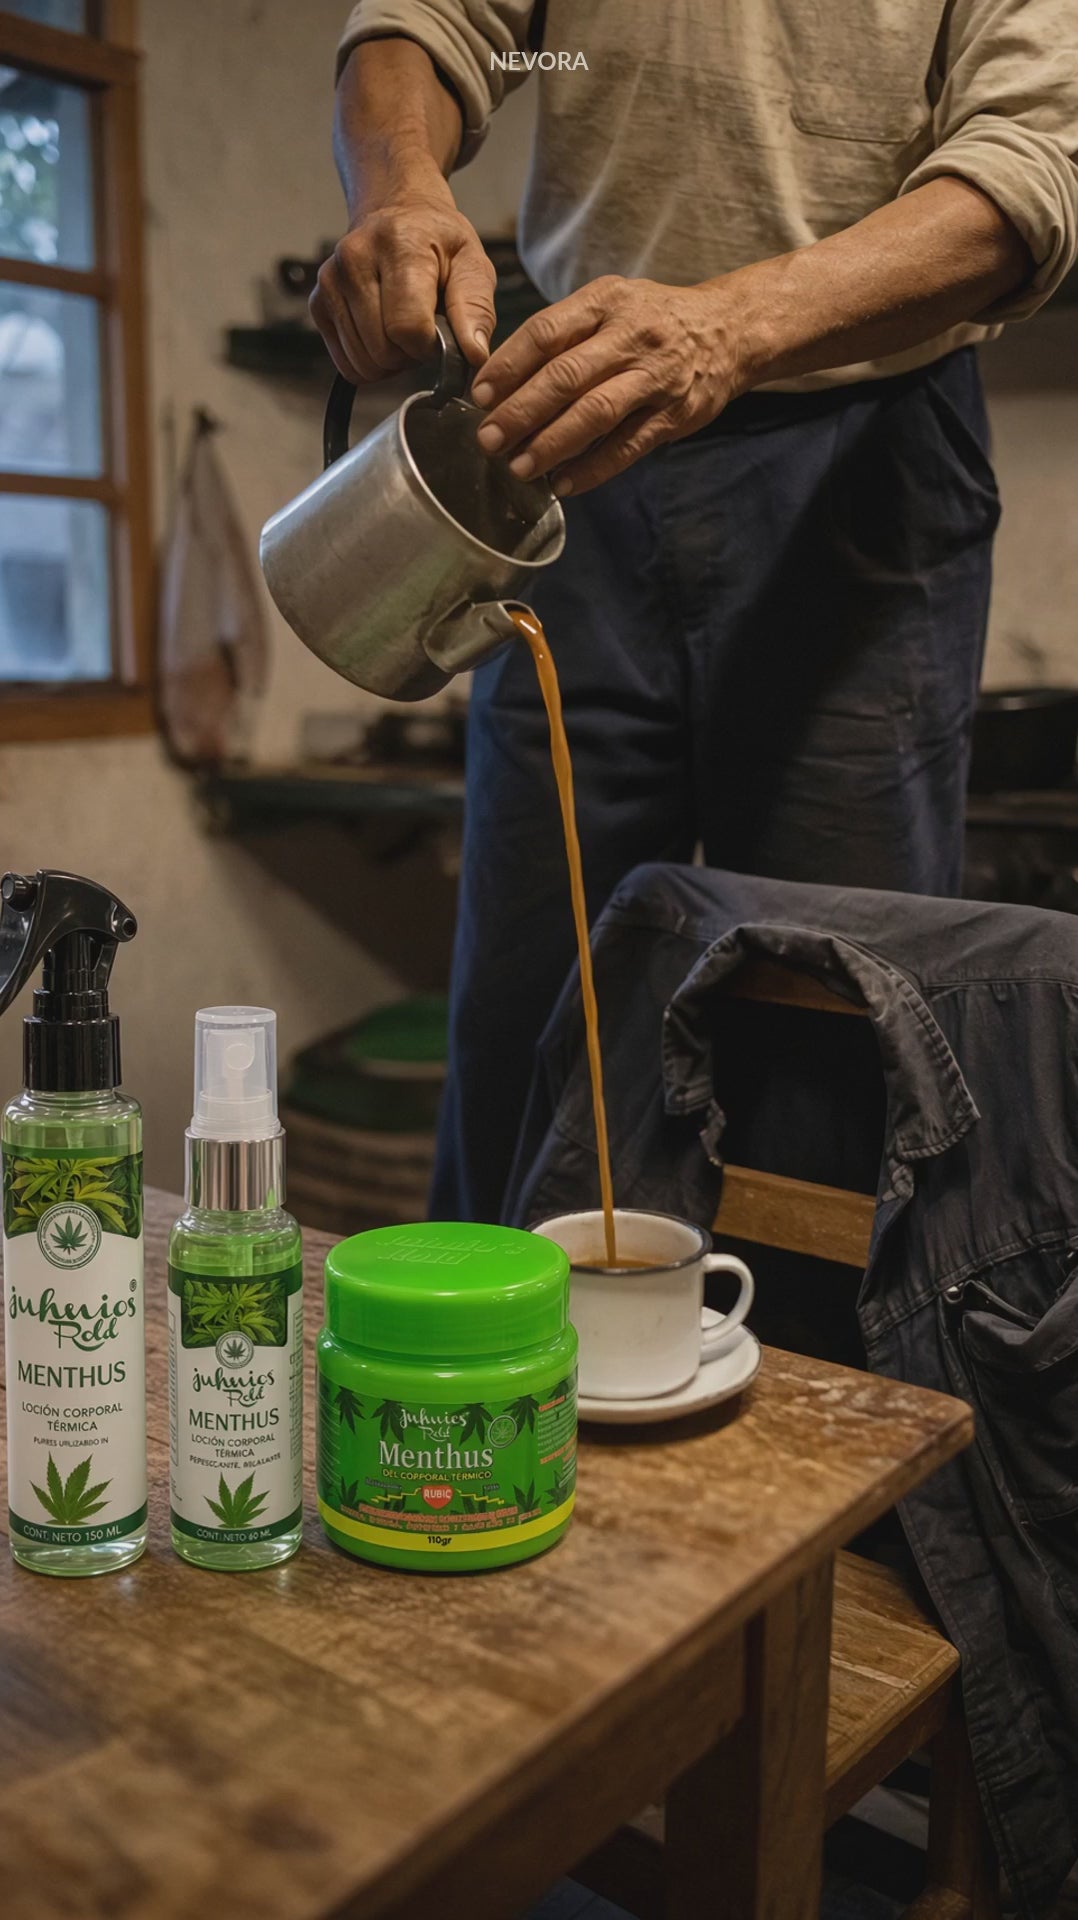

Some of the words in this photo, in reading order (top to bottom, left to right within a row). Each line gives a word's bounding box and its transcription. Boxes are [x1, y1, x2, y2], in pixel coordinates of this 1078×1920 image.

[18, 1360, 126, 1388] MENTHUS
[22, 1401, 60, 1417] LOCIÓN
[63, 1402, 123, 1418] CORPORAL
[47, 1419, 98, 1432] TÉRMICA
[189, 1408, 280, 1432] MENTHUS
[191, 1433, 225, 1447] LOCIÓN
[227, 1433, 276, 1448] CORPORAL
[379, 1440, 493, 1469] Menthus
[52, 1532, 82, 1543] NETO
[85, 1530, 104, 1540] 150
[106, 1527, 122, 1537] ML
[223, 1533, 247, 1542] NETO
[427, 1536, 453, 1546] 110gr
